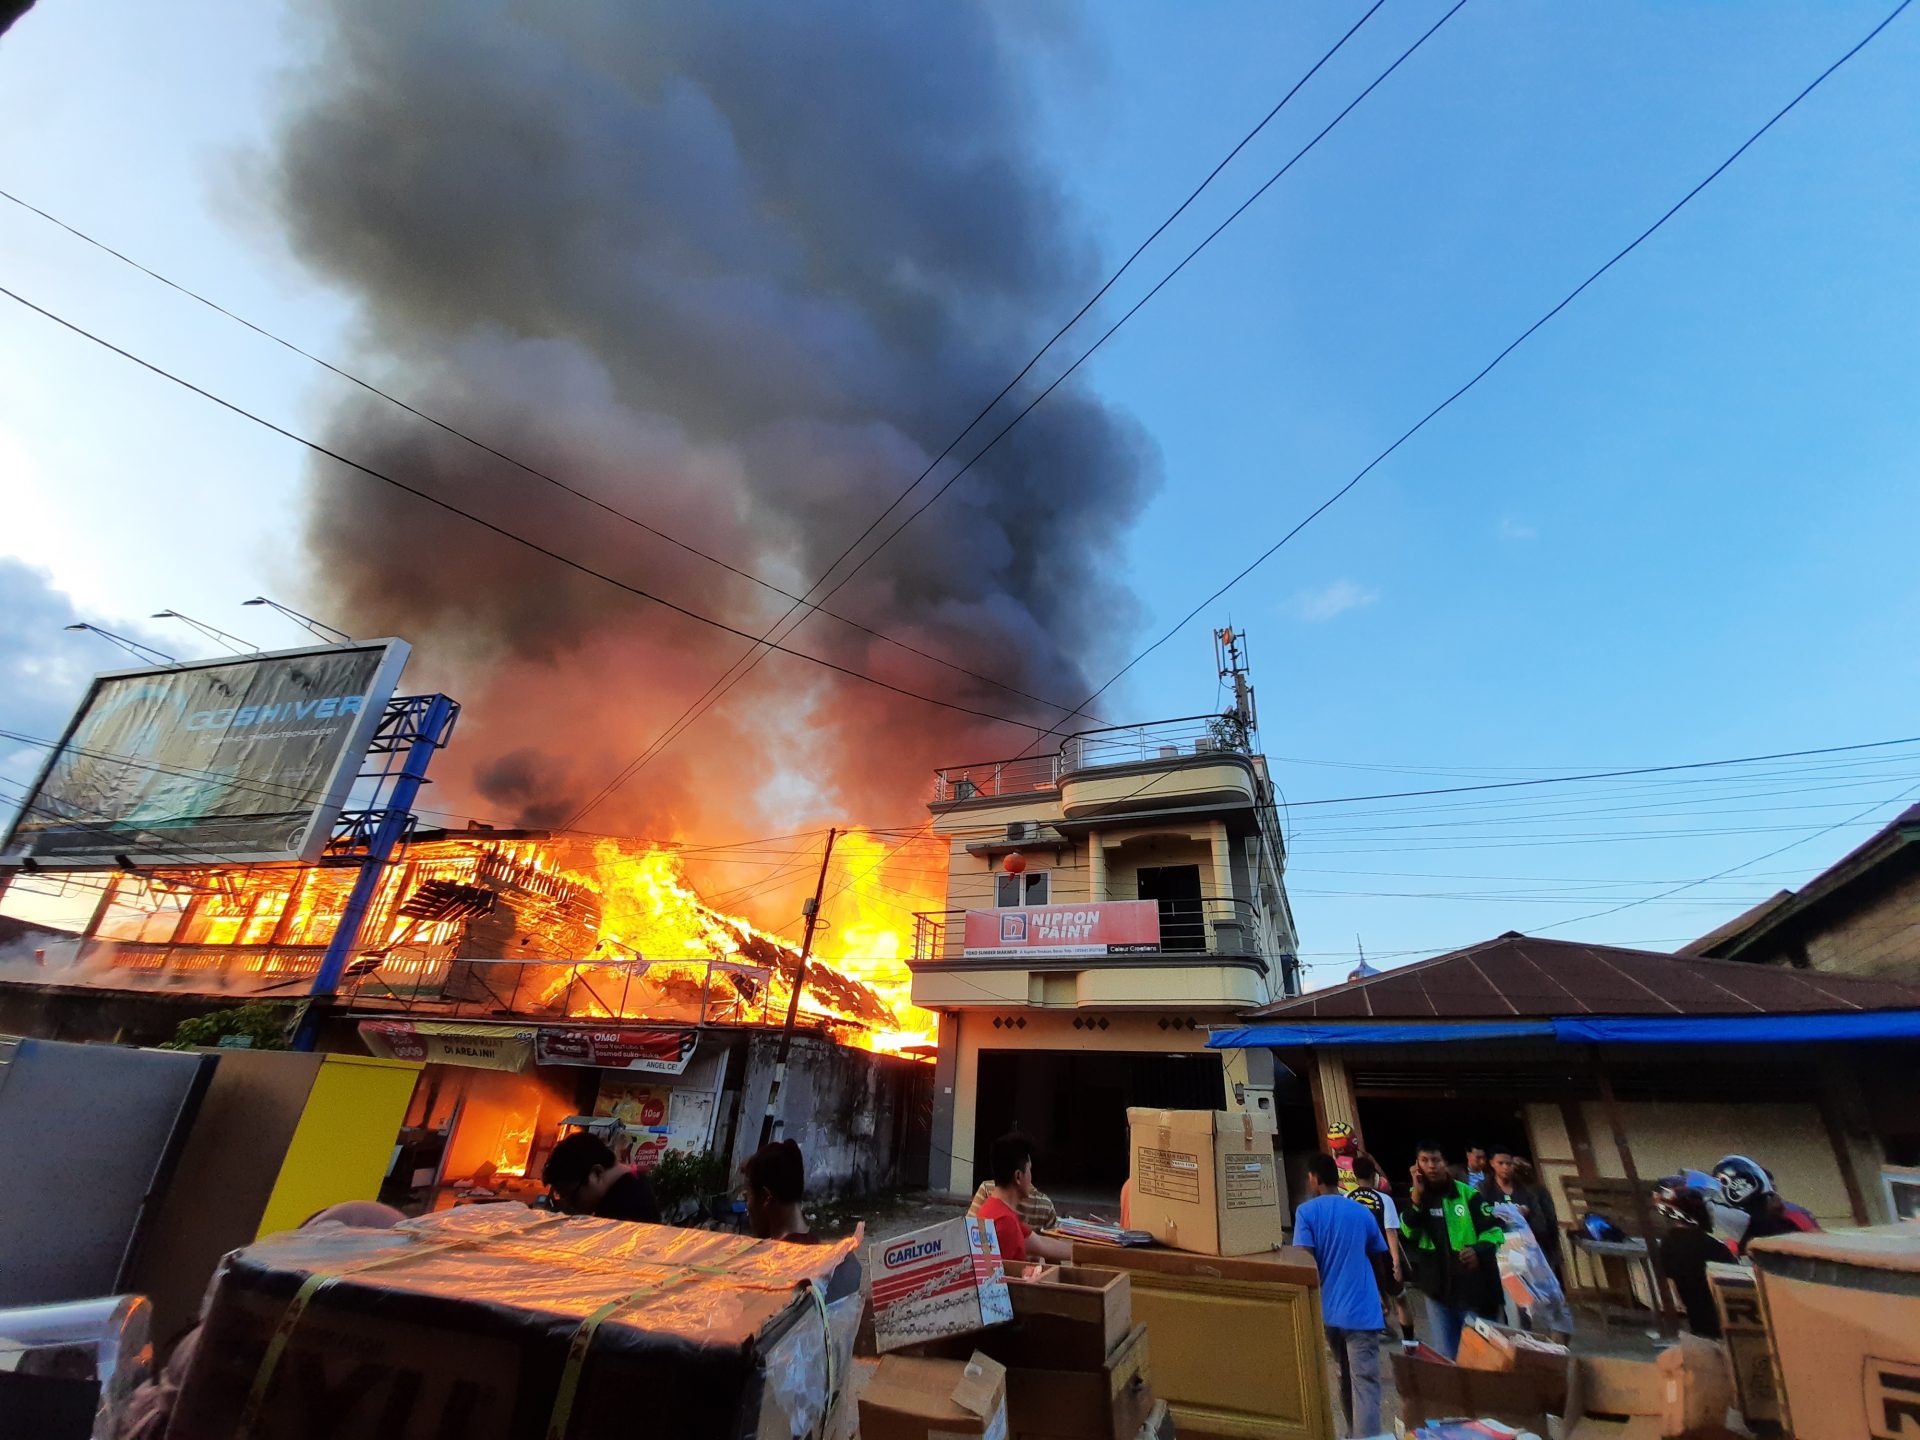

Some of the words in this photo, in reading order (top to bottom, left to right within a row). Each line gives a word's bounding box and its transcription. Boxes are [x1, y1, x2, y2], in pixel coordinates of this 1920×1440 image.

[1032, 911, 1100, 925] NIPPON
[1039, 925, 1093, 939] PAINT
[594, 1033, 620, 1042] OMG!
[444, 1046, 454, 1055] DI
[455, 1046, 478, 1057] AREA
[646, 1061, 666, 1069] ANGEL
[887, 1239, 943, 1265] CARLTON
